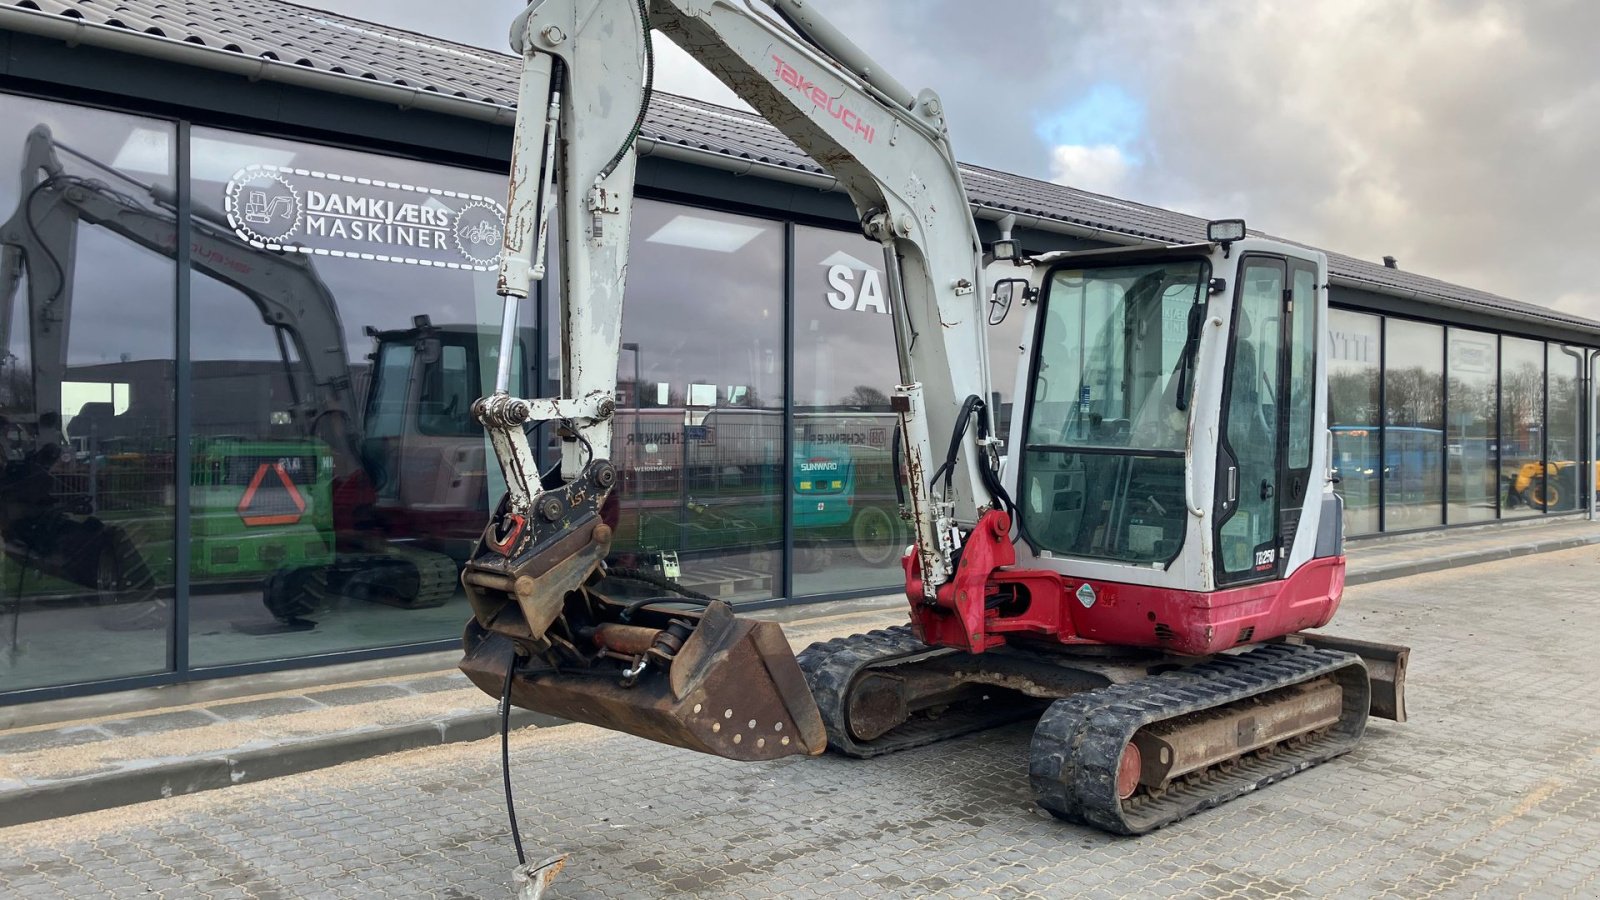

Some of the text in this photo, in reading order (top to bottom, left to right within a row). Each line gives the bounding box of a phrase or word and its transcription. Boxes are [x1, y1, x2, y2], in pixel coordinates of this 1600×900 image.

[306, 190, 450, 227] DAMKJÆRS
[306, 216, 448, 250] MASKINER
[827, 264, 892, 314] SA
[800, 461, 837, 472] SUNWARD
